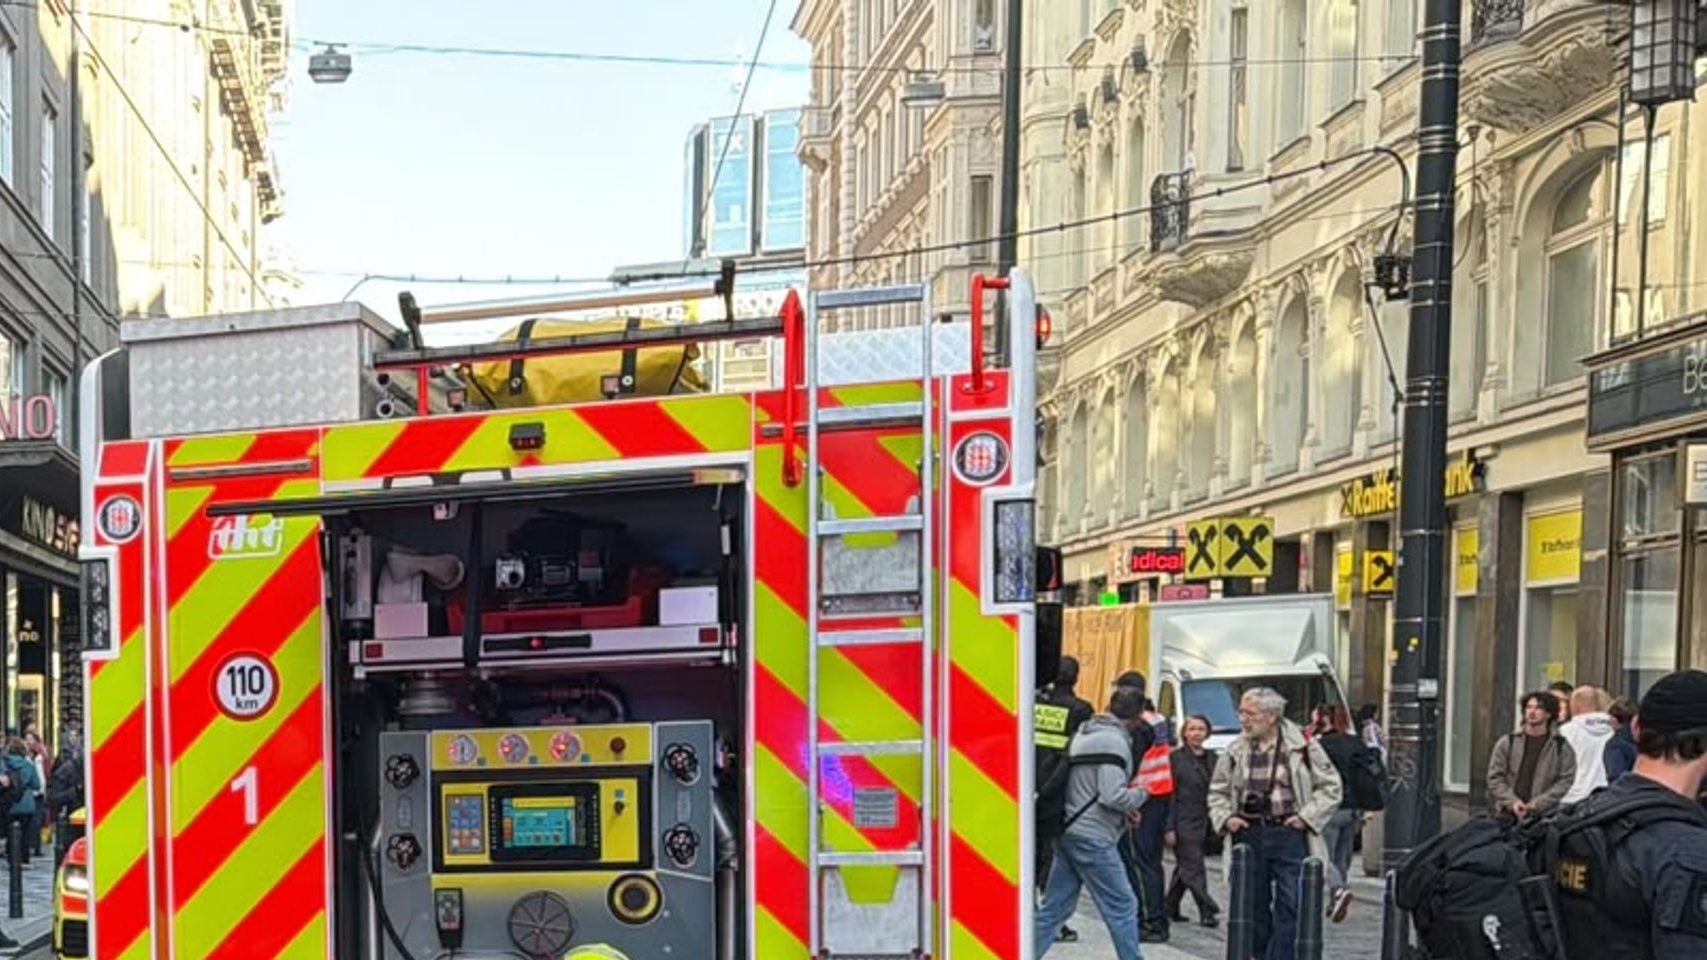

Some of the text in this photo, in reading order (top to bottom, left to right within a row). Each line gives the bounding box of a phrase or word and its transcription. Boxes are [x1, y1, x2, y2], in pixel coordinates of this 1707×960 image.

[226, 664, 265, 697] 110
[235, 698, 259, 710] km
[230, 765, 258, 825] 1
